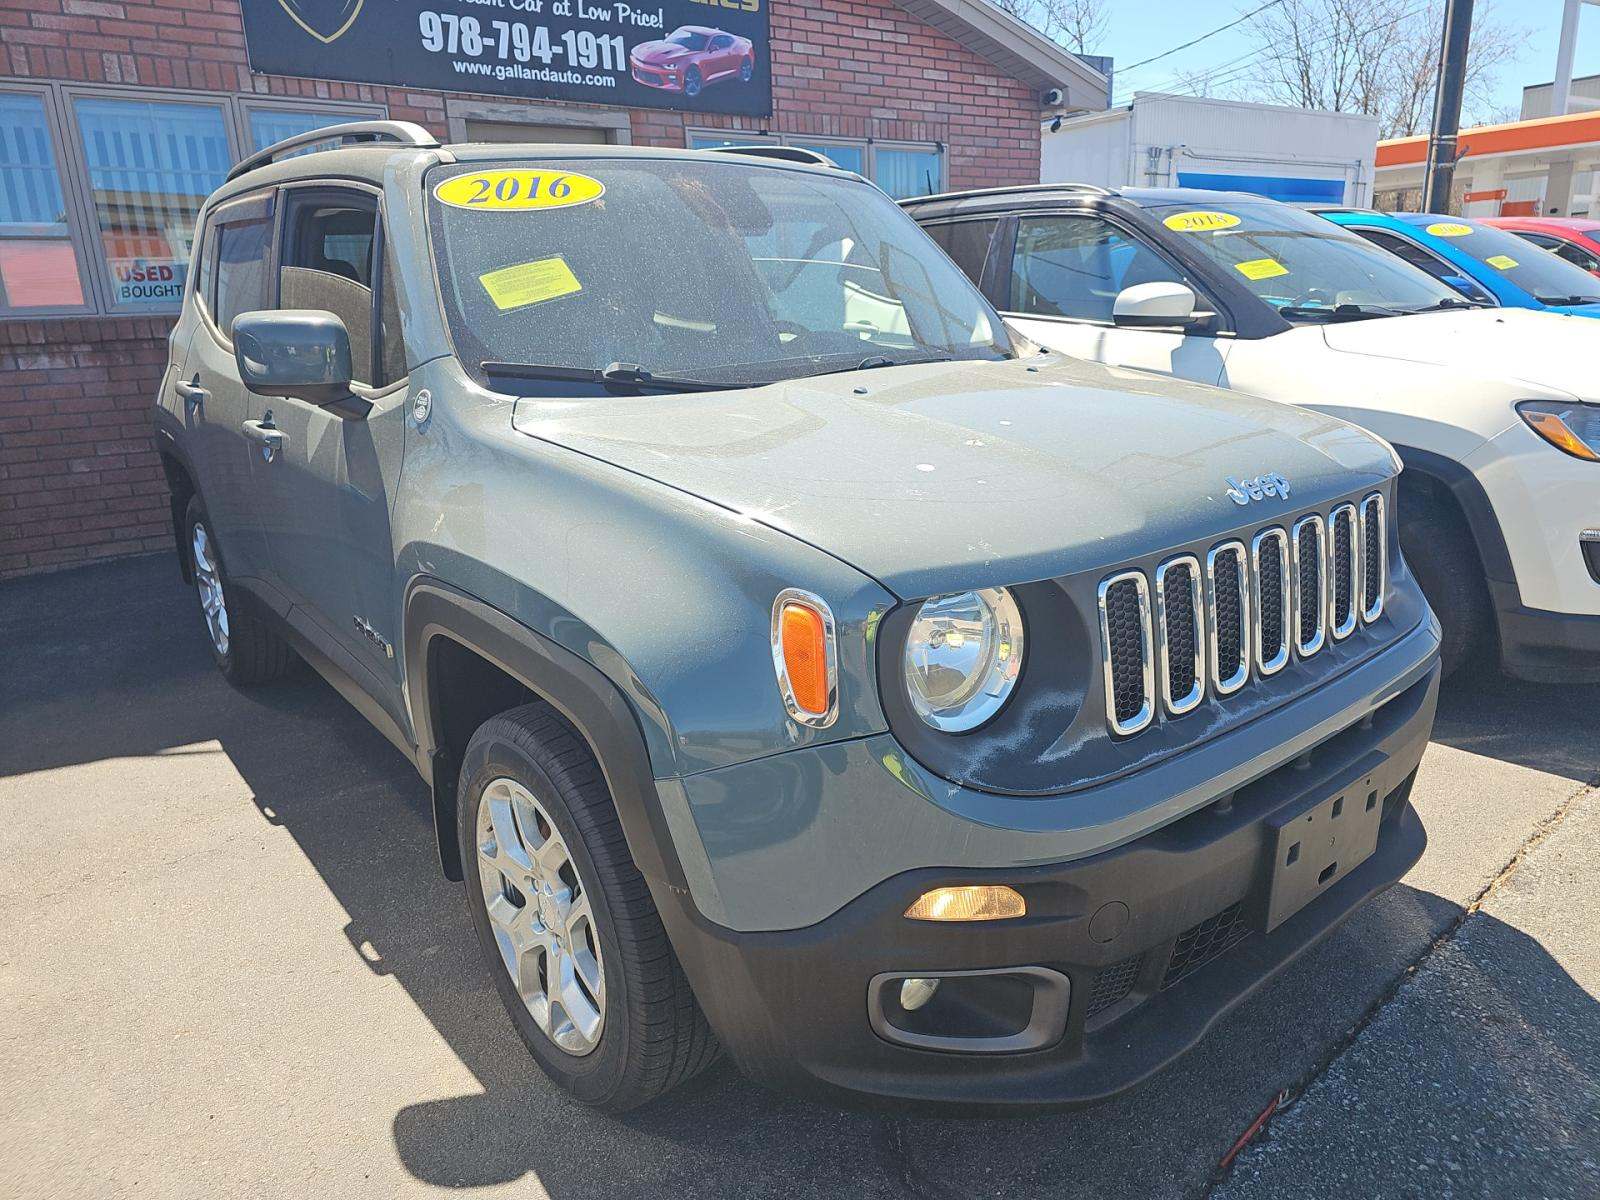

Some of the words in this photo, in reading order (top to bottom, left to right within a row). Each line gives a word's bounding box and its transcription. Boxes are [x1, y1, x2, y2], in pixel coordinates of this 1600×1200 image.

[552, 1, 572, 16] at
[577, 0, 611, 21] Low
[613, 3, 663, 28] Price!
[419, 11, 626, 71] 978-794-1911
[452, 60, 616, 87] www.gallandauto.com
[467, 176, 571, 204] 2016
[115, 265, 173, 283] USED
[121, 285, 183, 298] BOUGHT
[1224, 472, 1290, 505] Jeep
